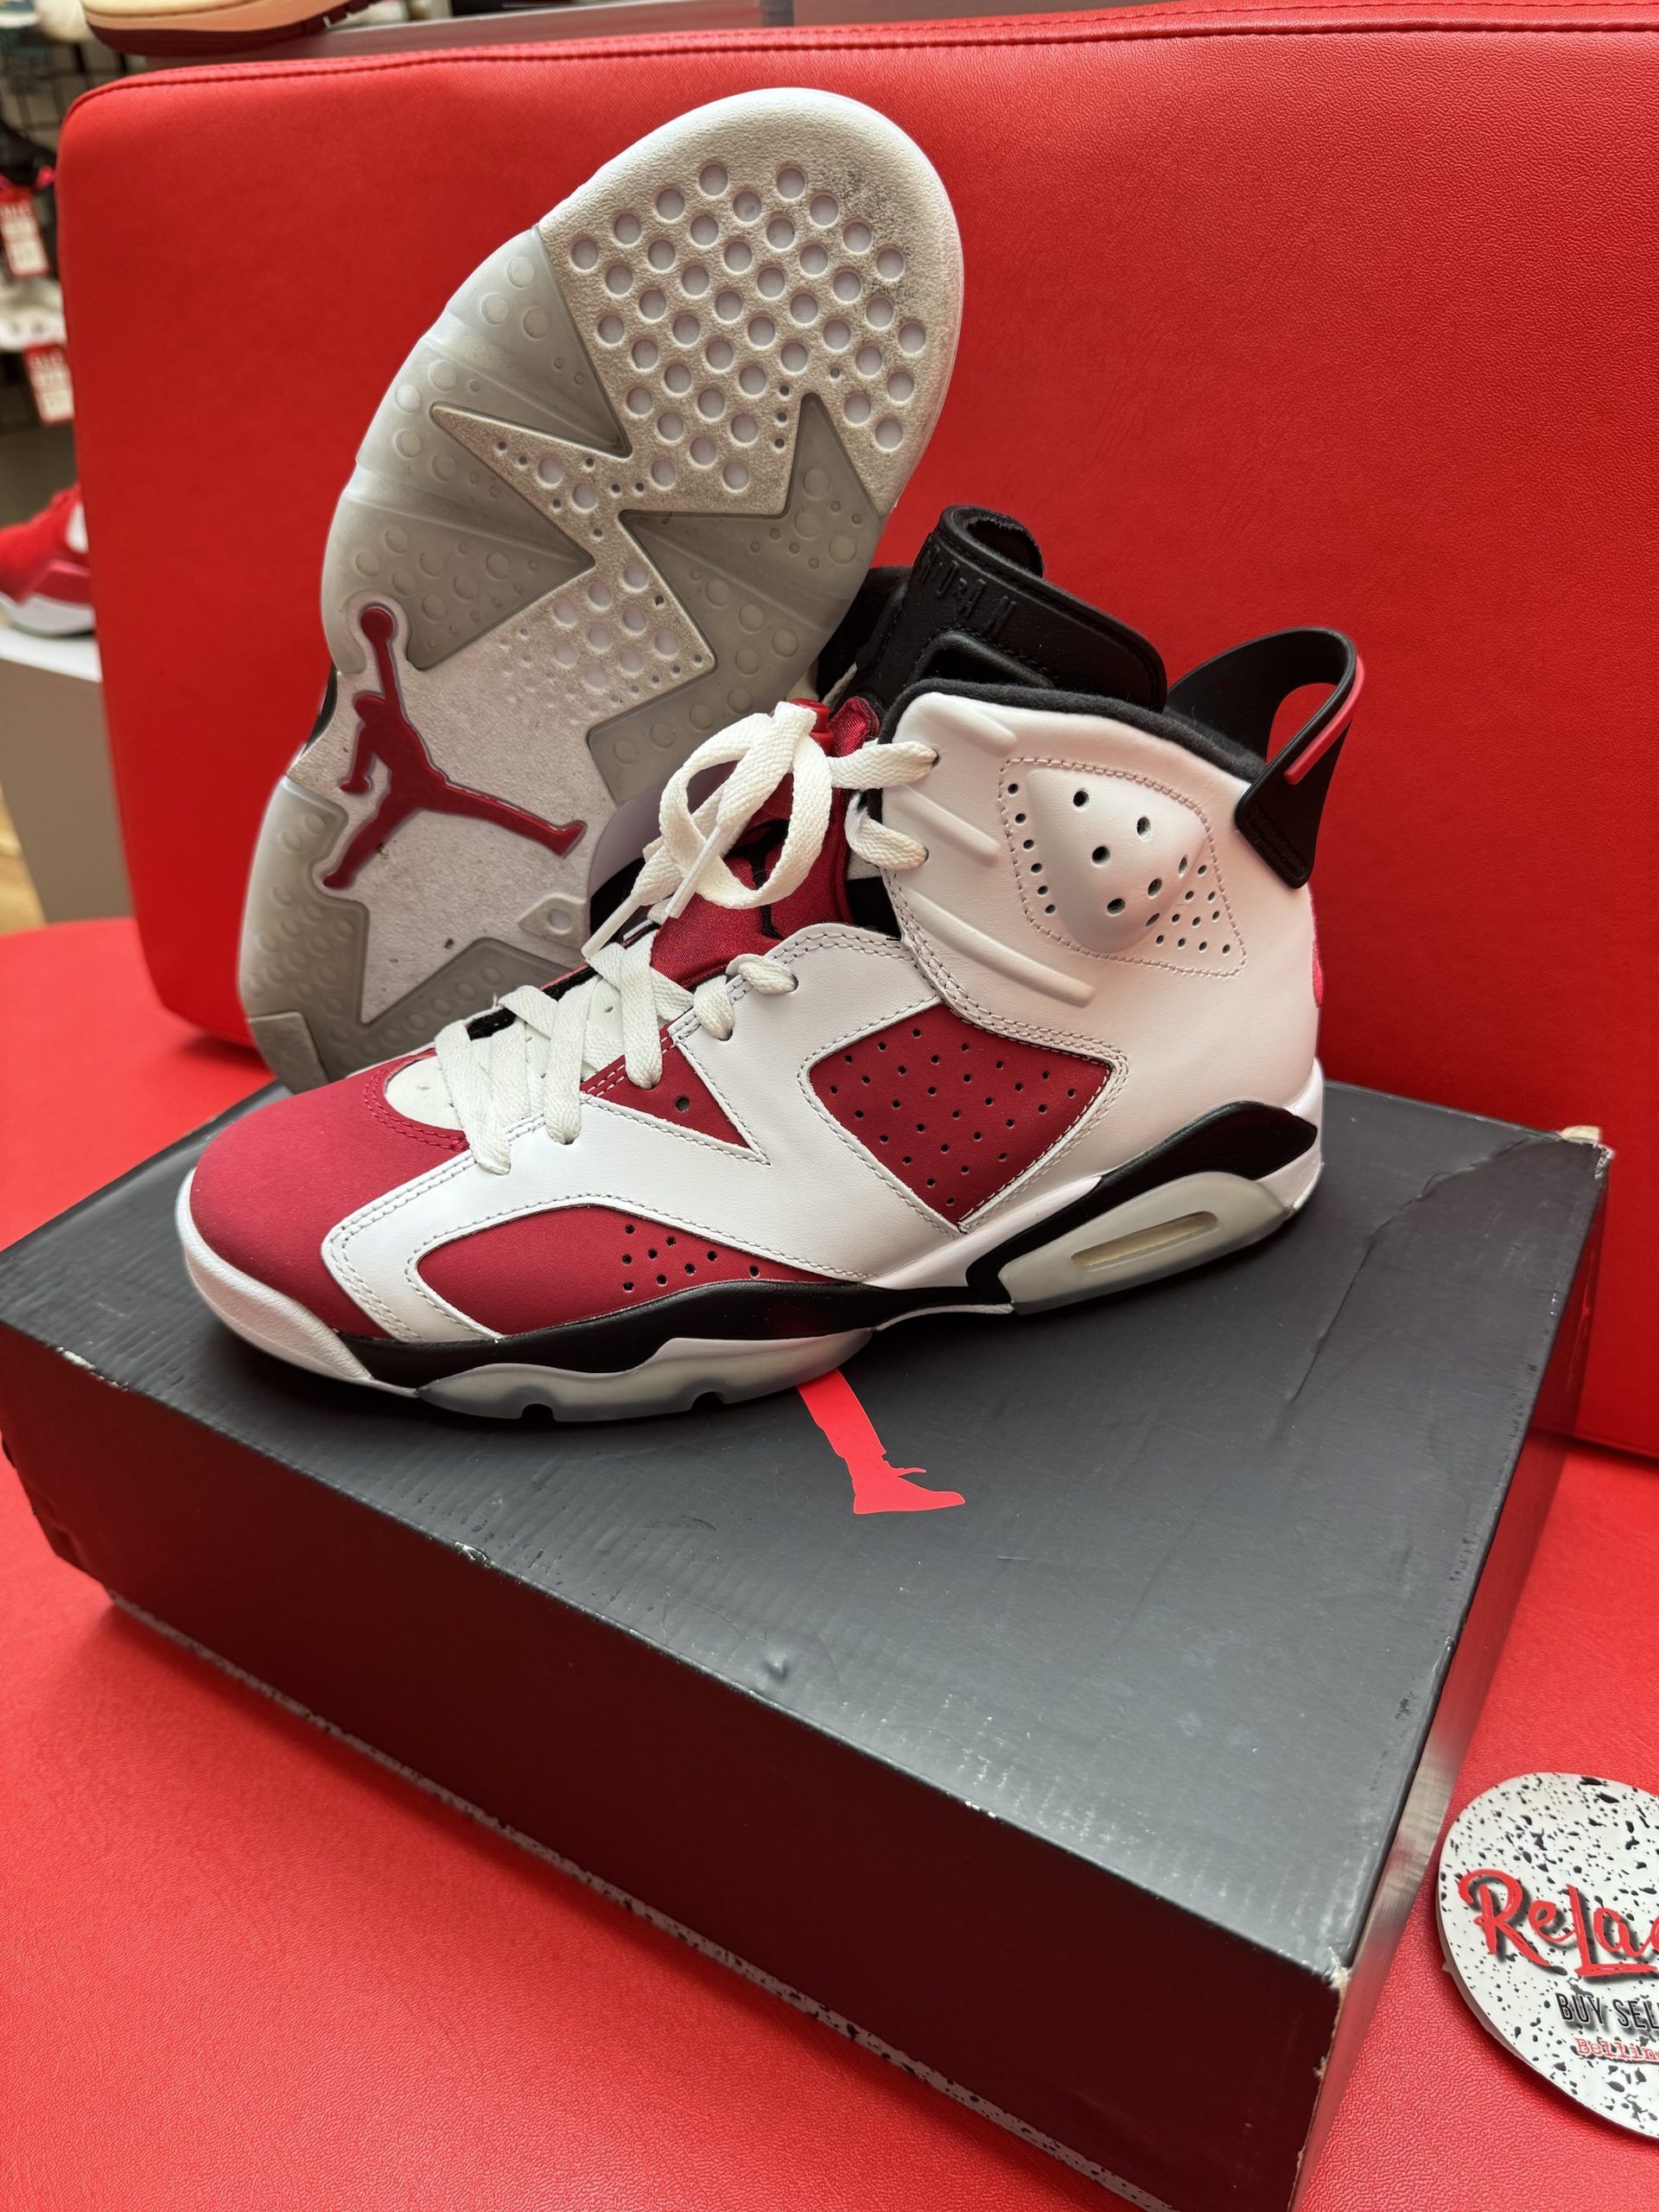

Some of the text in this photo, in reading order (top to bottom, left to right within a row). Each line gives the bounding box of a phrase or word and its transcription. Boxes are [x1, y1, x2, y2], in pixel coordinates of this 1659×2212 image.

[1458, 1868, 1659, 1977] ReLa
[1555, 1993, 1659, 2030] BUY SEL
